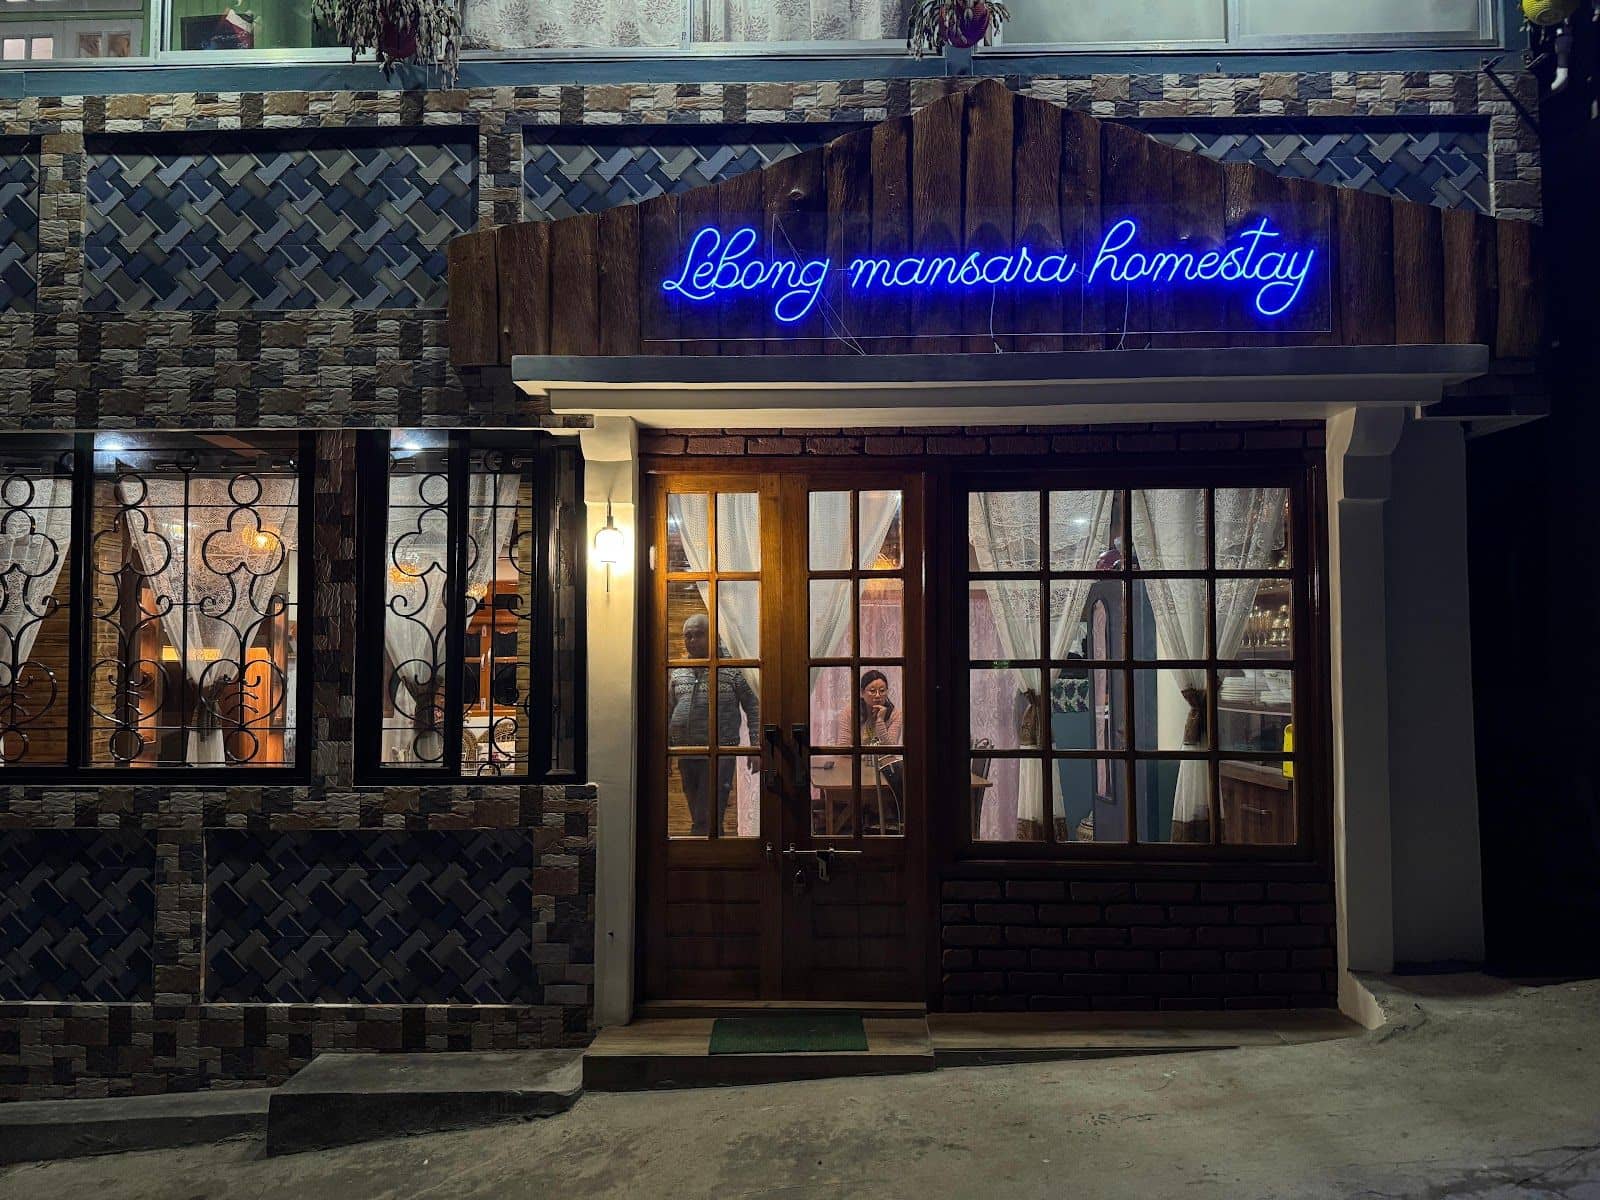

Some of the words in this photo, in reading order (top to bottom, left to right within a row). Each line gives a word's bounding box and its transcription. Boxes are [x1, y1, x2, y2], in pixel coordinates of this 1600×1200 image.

[662, 227, 831, 323] Lebong
[849, 246, 1077, 289] mansara
[1087, 217, 1316, 317] homestay
